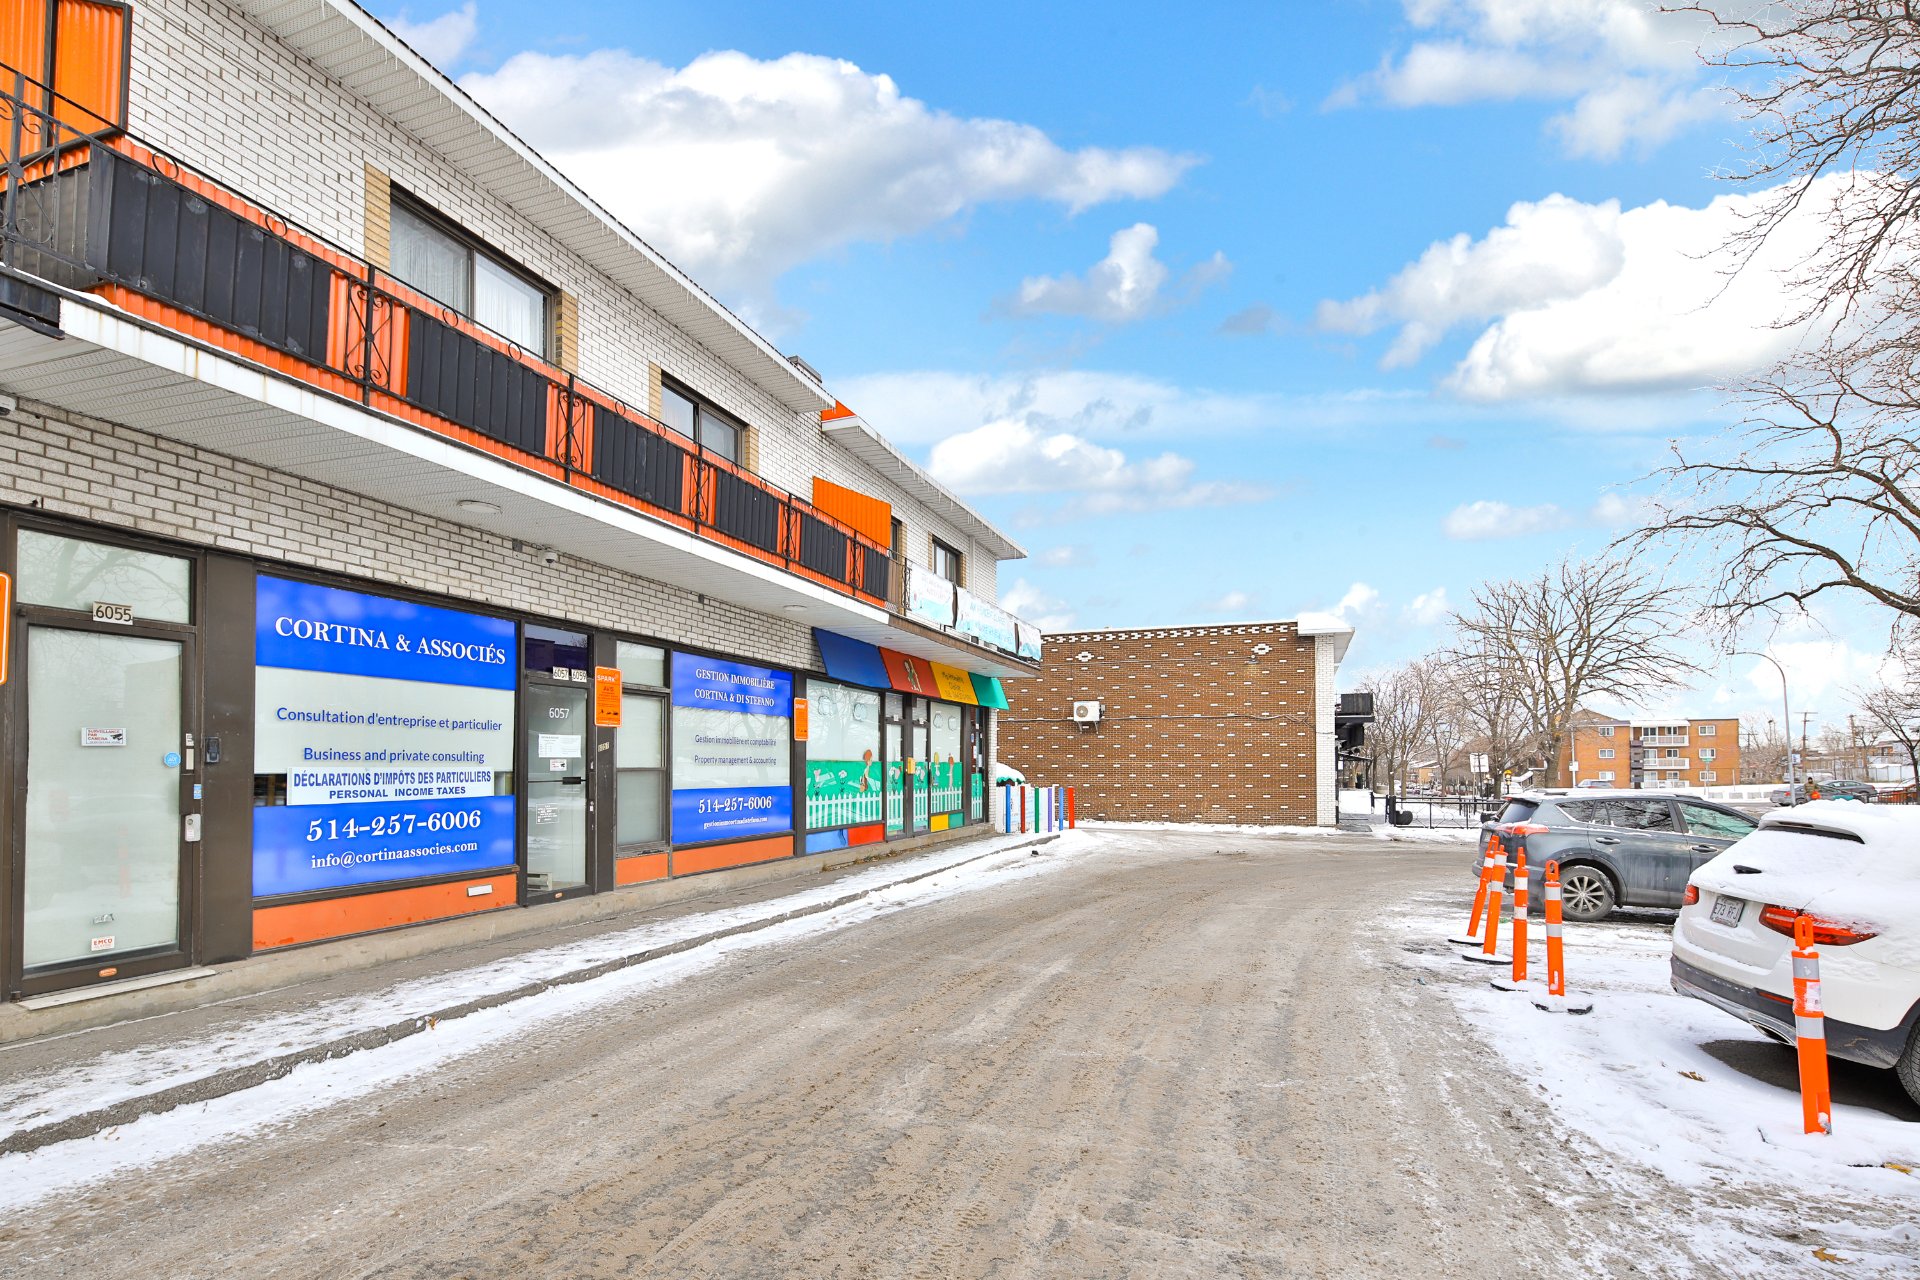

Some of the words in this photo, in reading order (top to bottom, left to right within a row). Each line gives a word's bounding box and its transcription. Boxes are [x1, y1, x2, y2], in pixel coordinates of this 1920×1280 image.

[96, 605, 131, 622] 6055
[275, 616, 390, 650] CORTINA
[395, 634, 411, 652] &
[416, 637, 506, 665] ASSOCIÉS
[553, 668, 569, 679] 6057
[572, 670, 587, 681] 6059
[597, 674, 616, 682] SPARK
[695, 668, 730, 682] GESTION
[731, 674, 776, 690] IMMOBILIÈRE
[694, 688, 728, 702] CORTINA
[729, 693, 735, 702] &
[736, 693, 745, 704] DI
[745, 695, 775, 707] STEFANO
[276, 707, 364, 724] Consultation
[367, 712, 437, 729] d'entreprise
[439, 718, 450, 729] et
[452, 719, 502, 731] particulier
[549, 707, 570, 719] 6057
[694, 734, 716, 744] Gestion
[303, 747, 361, 761] Business
[364, 748, 387, 761] and
[389, 749, 430, 763] private
[432, 750, 485, 764] consulting
[694, 754, 717, 765] Property
[718, 756, 748, 766] management
[753, 757, 777, 766] accounting
[293, 769, 371, 787] DÉCLARATIONS
[373, 769, 415, 785] D'IMPÔTS
[418, 772, 434, 784] DES
[436, 770, 491, 784] PARTICULIERS
[329, 788, 388, 799] PERSONAL
[394, 787, 434, 797] INCOME
[436, 786, 466, 795] TAXES
[698, 795, 772, 814] 514-257-6006
[306, 809, 481, 842] 514-257-6006
[311, 841, 478, 869] info@cortinaassocies.com
[93, 938, 112, 946] EMCO
